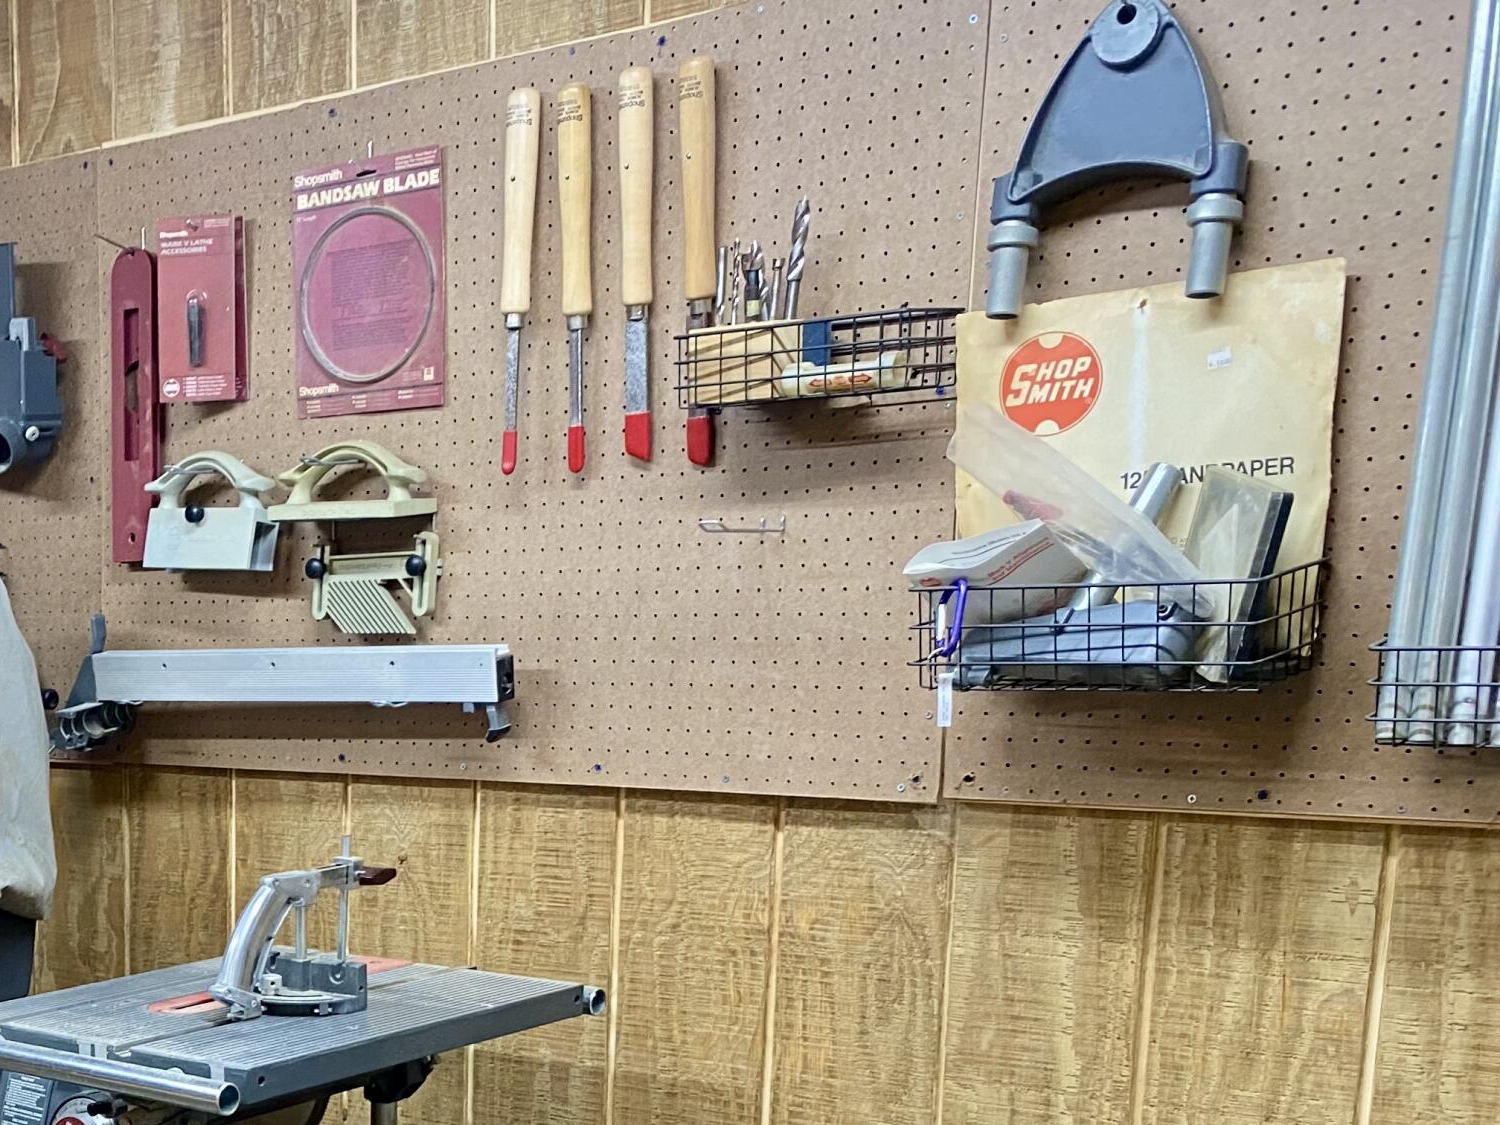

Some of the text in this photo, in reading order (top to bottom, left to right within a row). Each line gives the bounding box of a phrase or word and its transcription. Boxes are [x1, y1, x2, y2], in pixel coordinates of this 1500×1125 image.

[294, 168, 342, 188] Shopsmith
[297, 168, 440, 210] BANDSAW BLADE
[299, 383, 339, 396] Shopsmith
